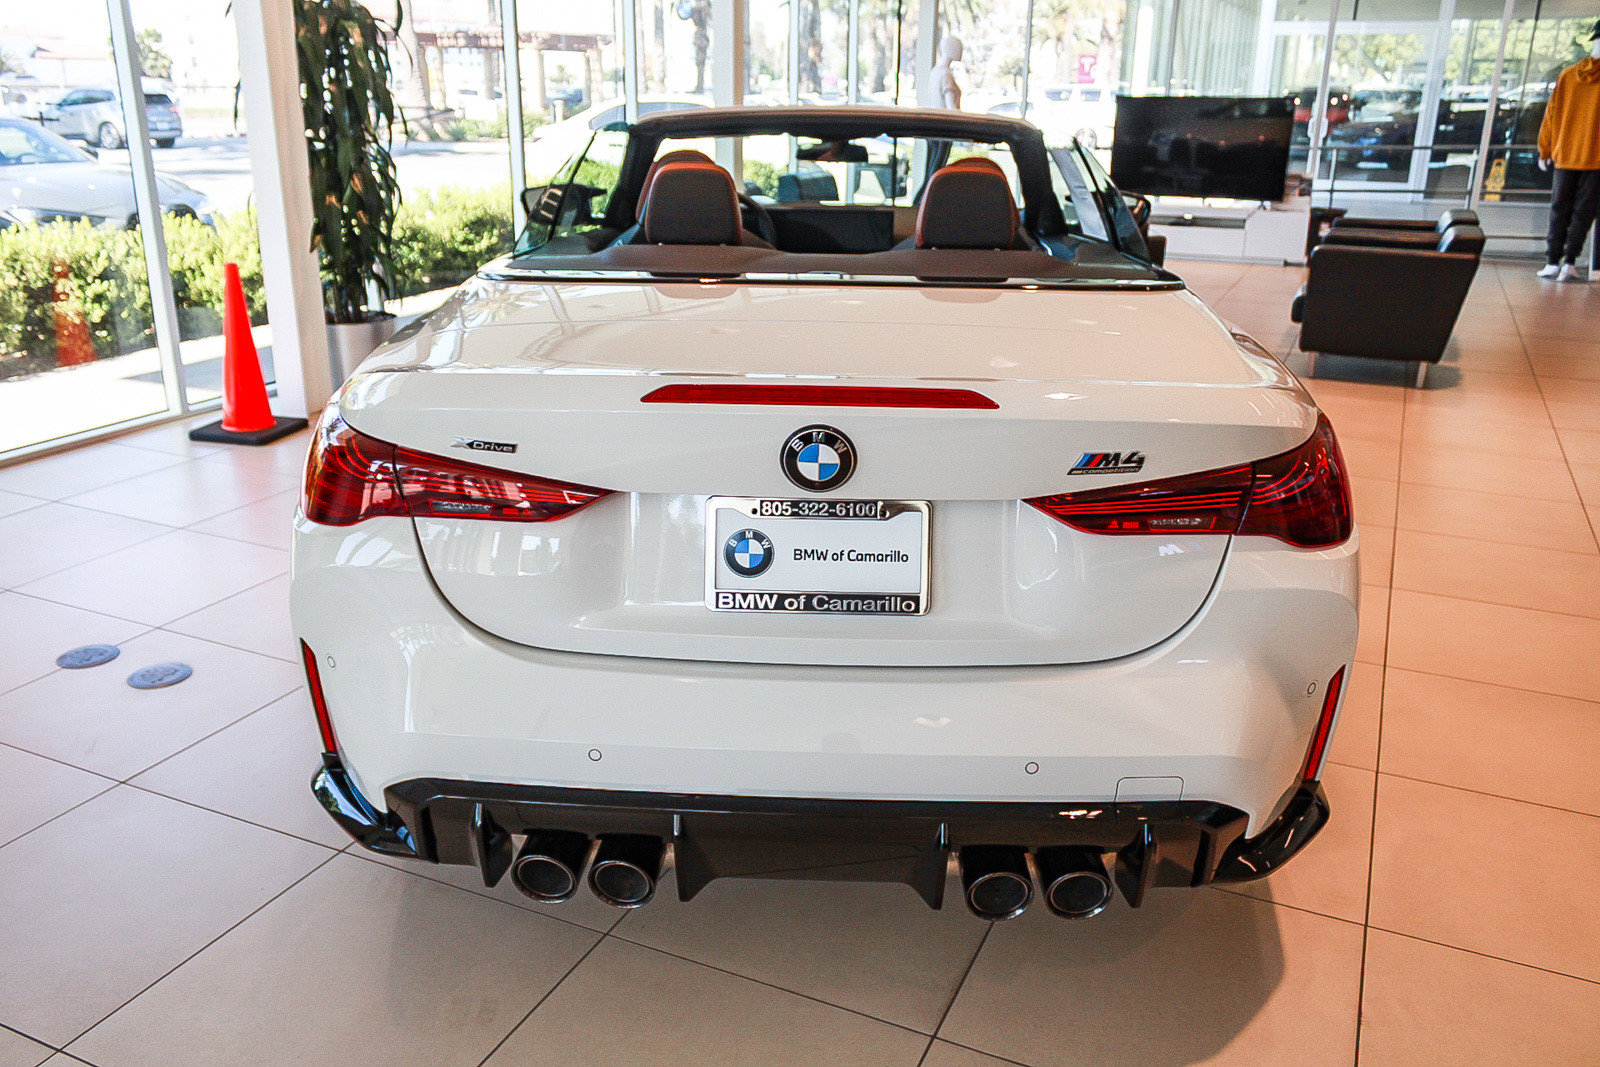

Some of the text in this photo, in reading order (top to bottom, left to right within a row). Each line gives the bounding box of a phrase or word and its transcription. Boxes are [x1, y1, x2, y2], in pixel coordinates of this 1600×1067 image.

[791, 431, 847, 453] BMW
[761, 502, 876, 517] 805-322-6100
[729, 530, 772, 549] BMW
[793, 549, 909, 563] BMW of Camarillo
[718, 593, 915, 612] BMW of Camarillo
